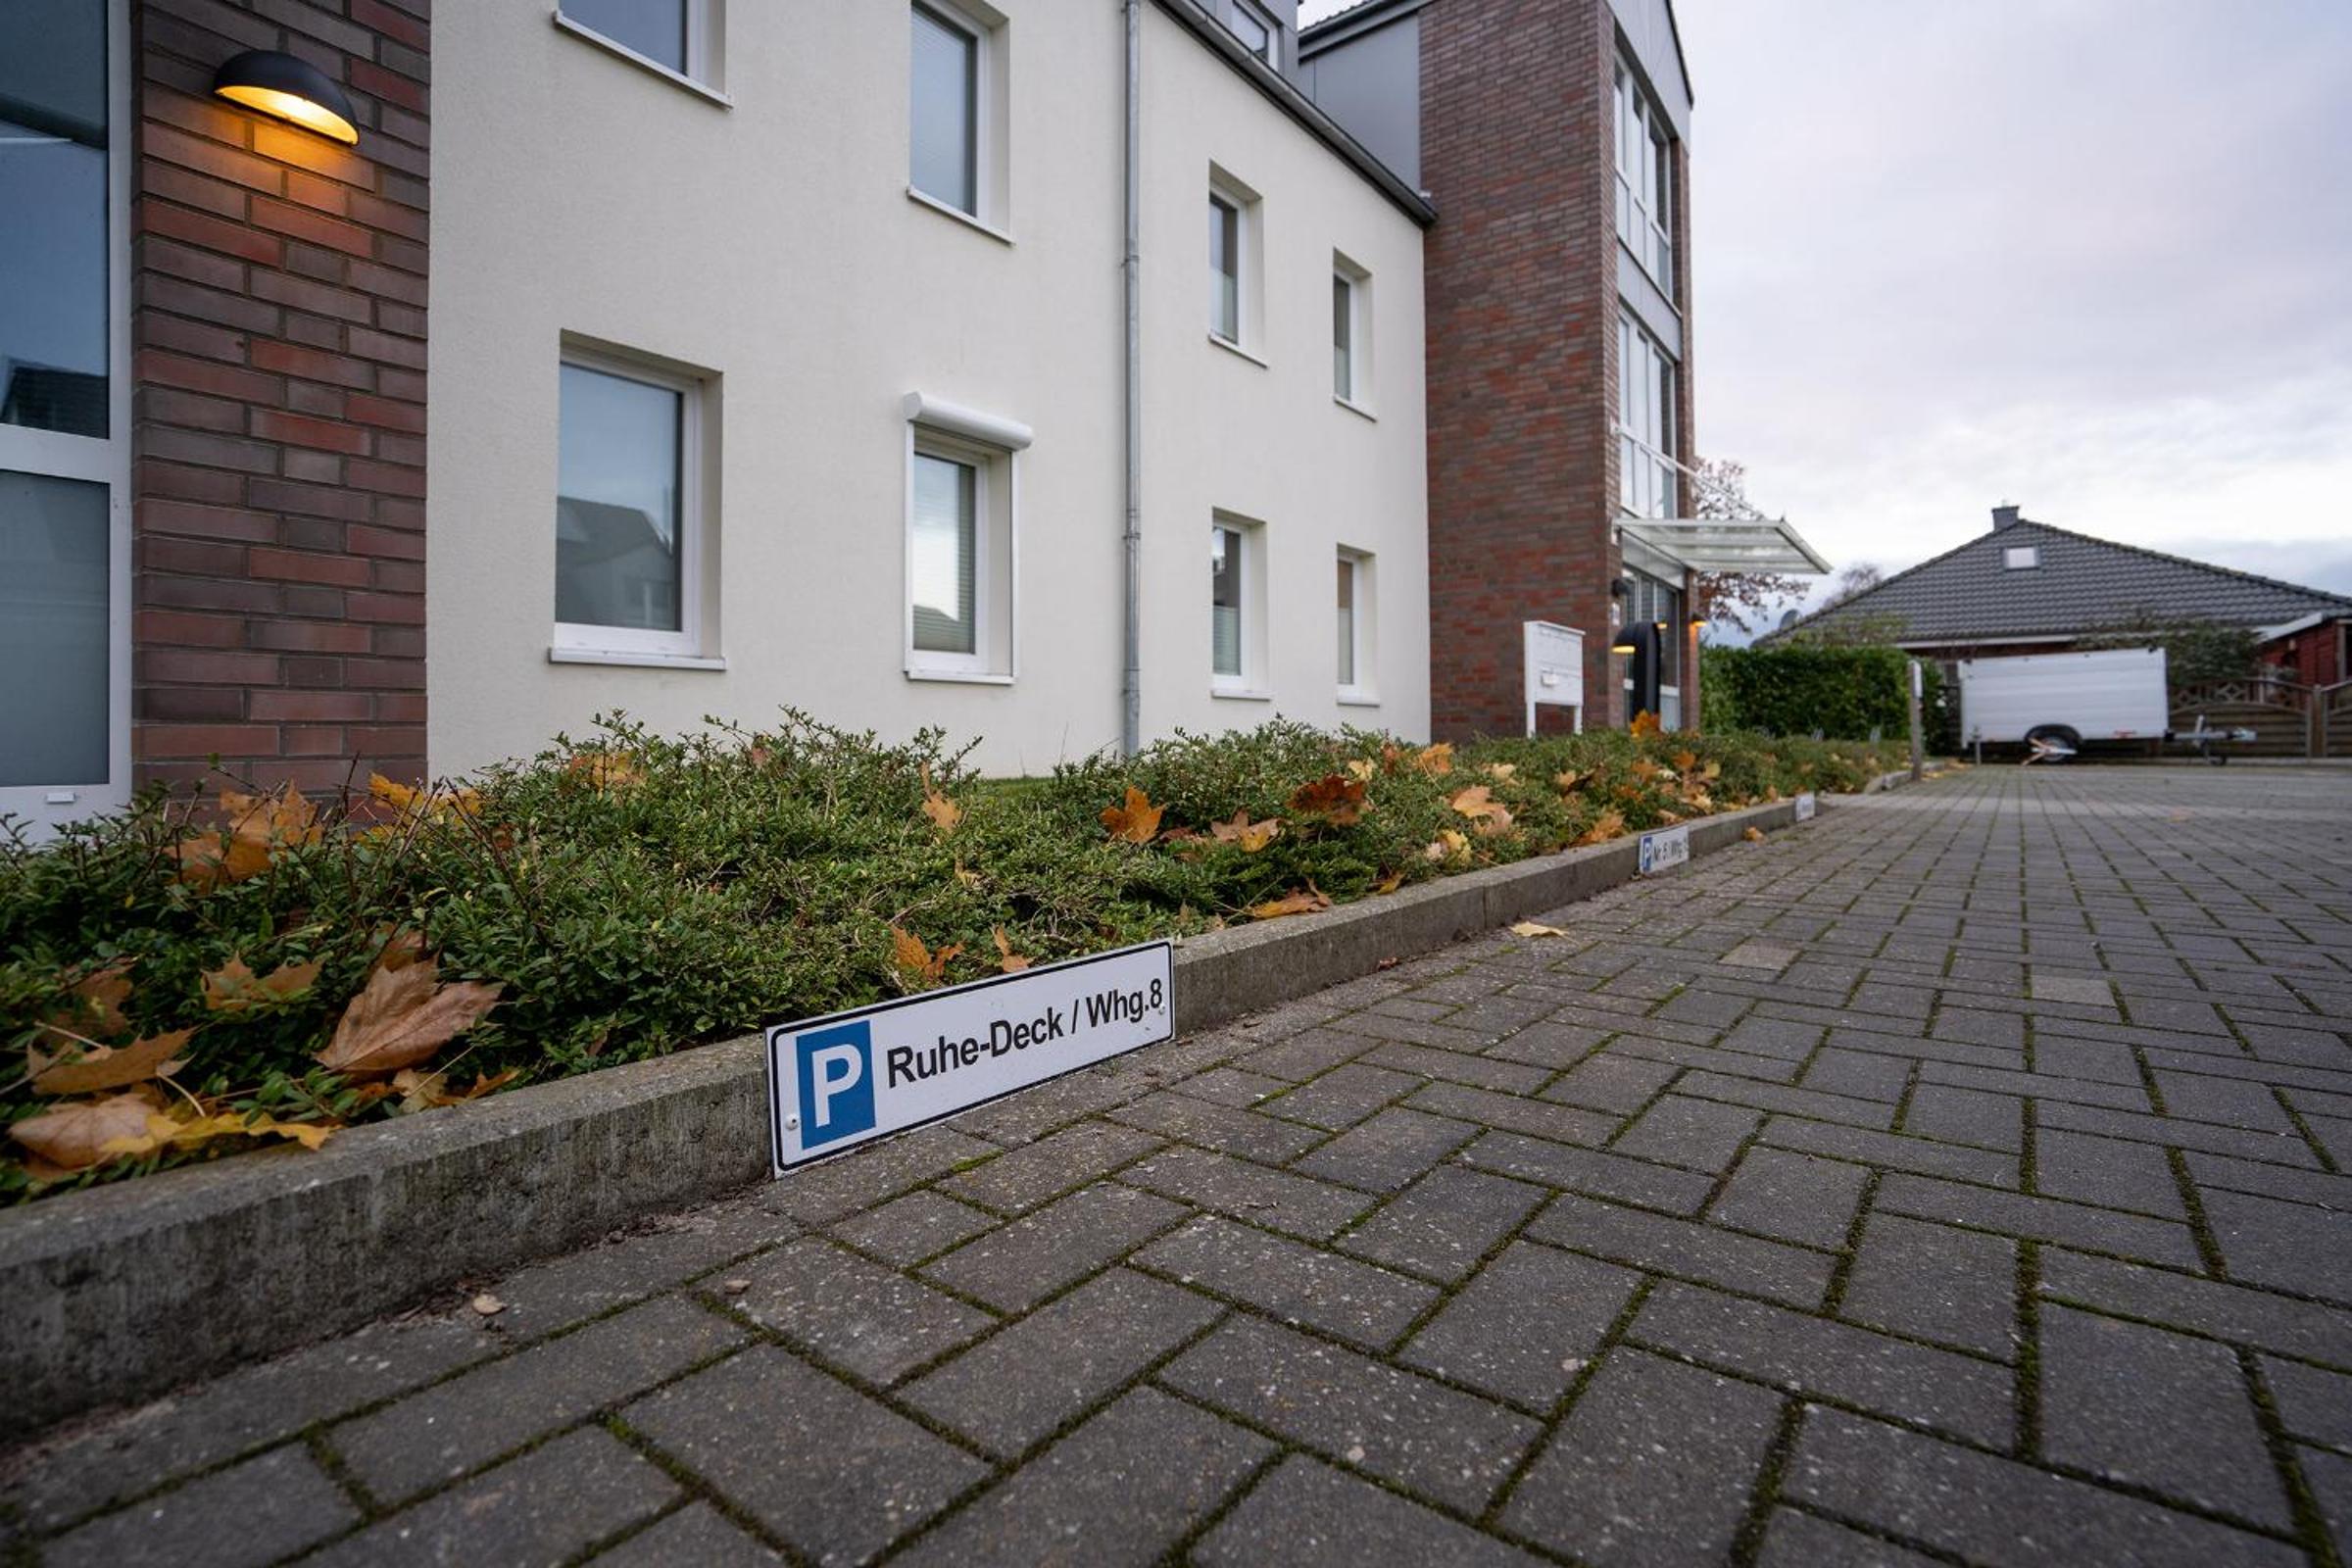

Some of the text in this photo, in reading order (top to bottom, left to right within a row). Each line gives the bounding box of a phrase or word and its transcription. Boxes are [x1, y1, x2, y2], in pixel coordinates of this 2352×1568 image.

[811, 1044, 863, 1128] P
[887, 1006, 1064, 1089] Ruhe-Deck
[1085, 978, 1163, 1028] Whg.8
